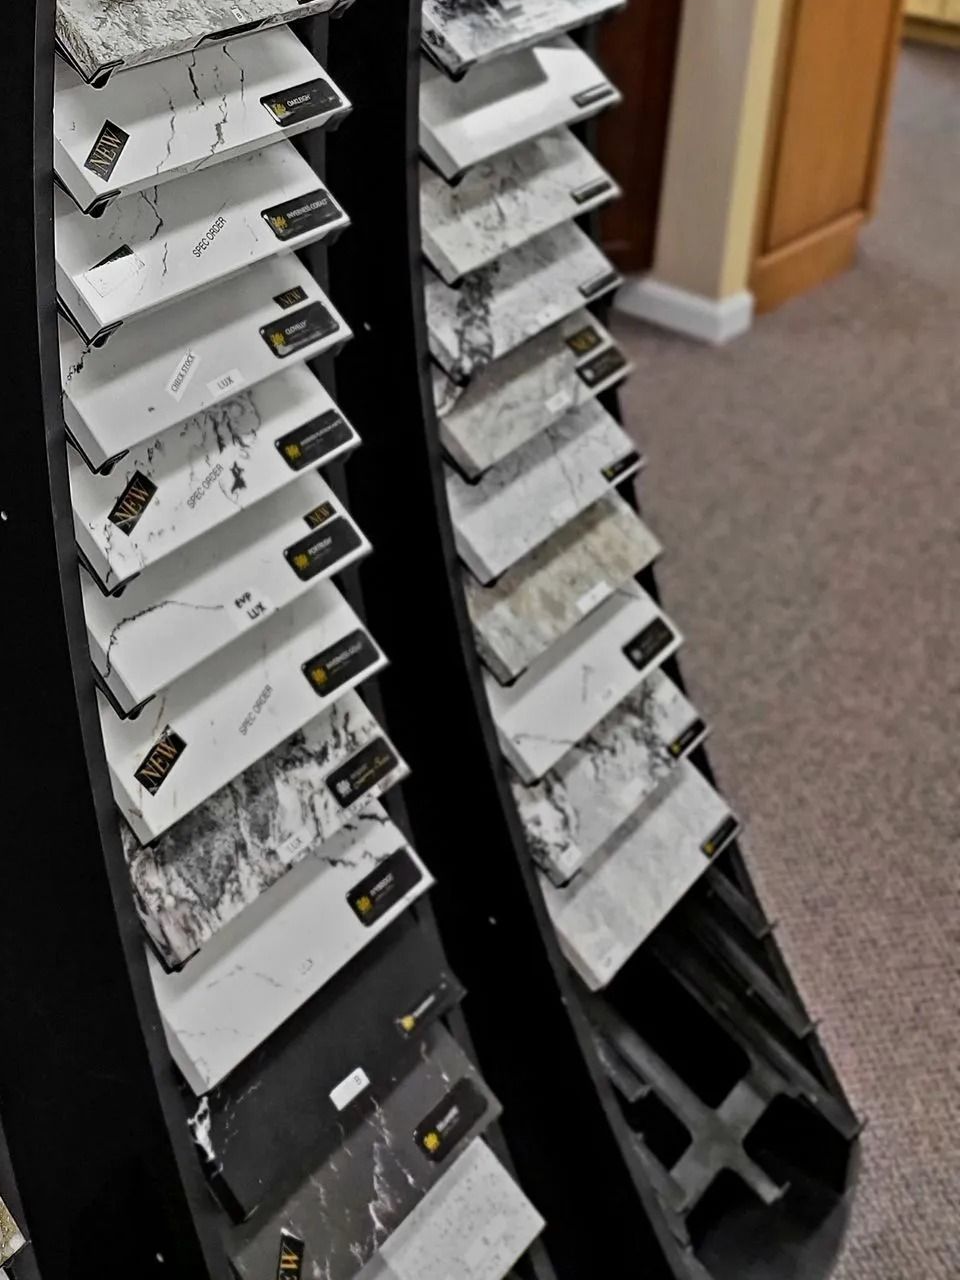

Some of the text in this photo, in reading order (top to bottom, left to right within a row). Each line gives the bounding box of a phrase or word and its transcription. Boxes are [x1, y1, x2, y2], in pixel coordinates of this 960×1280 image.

[90, 127, 123, 174] NEW
[192, 216, 227, 258] SPEC ORDER
[279, 288, 301, 306] NEW
[171, 354, 195, 393] CHECK STOCK
[217, 375, 235, 390] LUX
[186, 463, 224, 509] SPEC ORDER
[309, 506, 330, 526] NEW
[247, 601, 268, 620] LUX
[238, 684, 273, 736] SPEC ORDER
[140, 732, 178, 786] NEW
